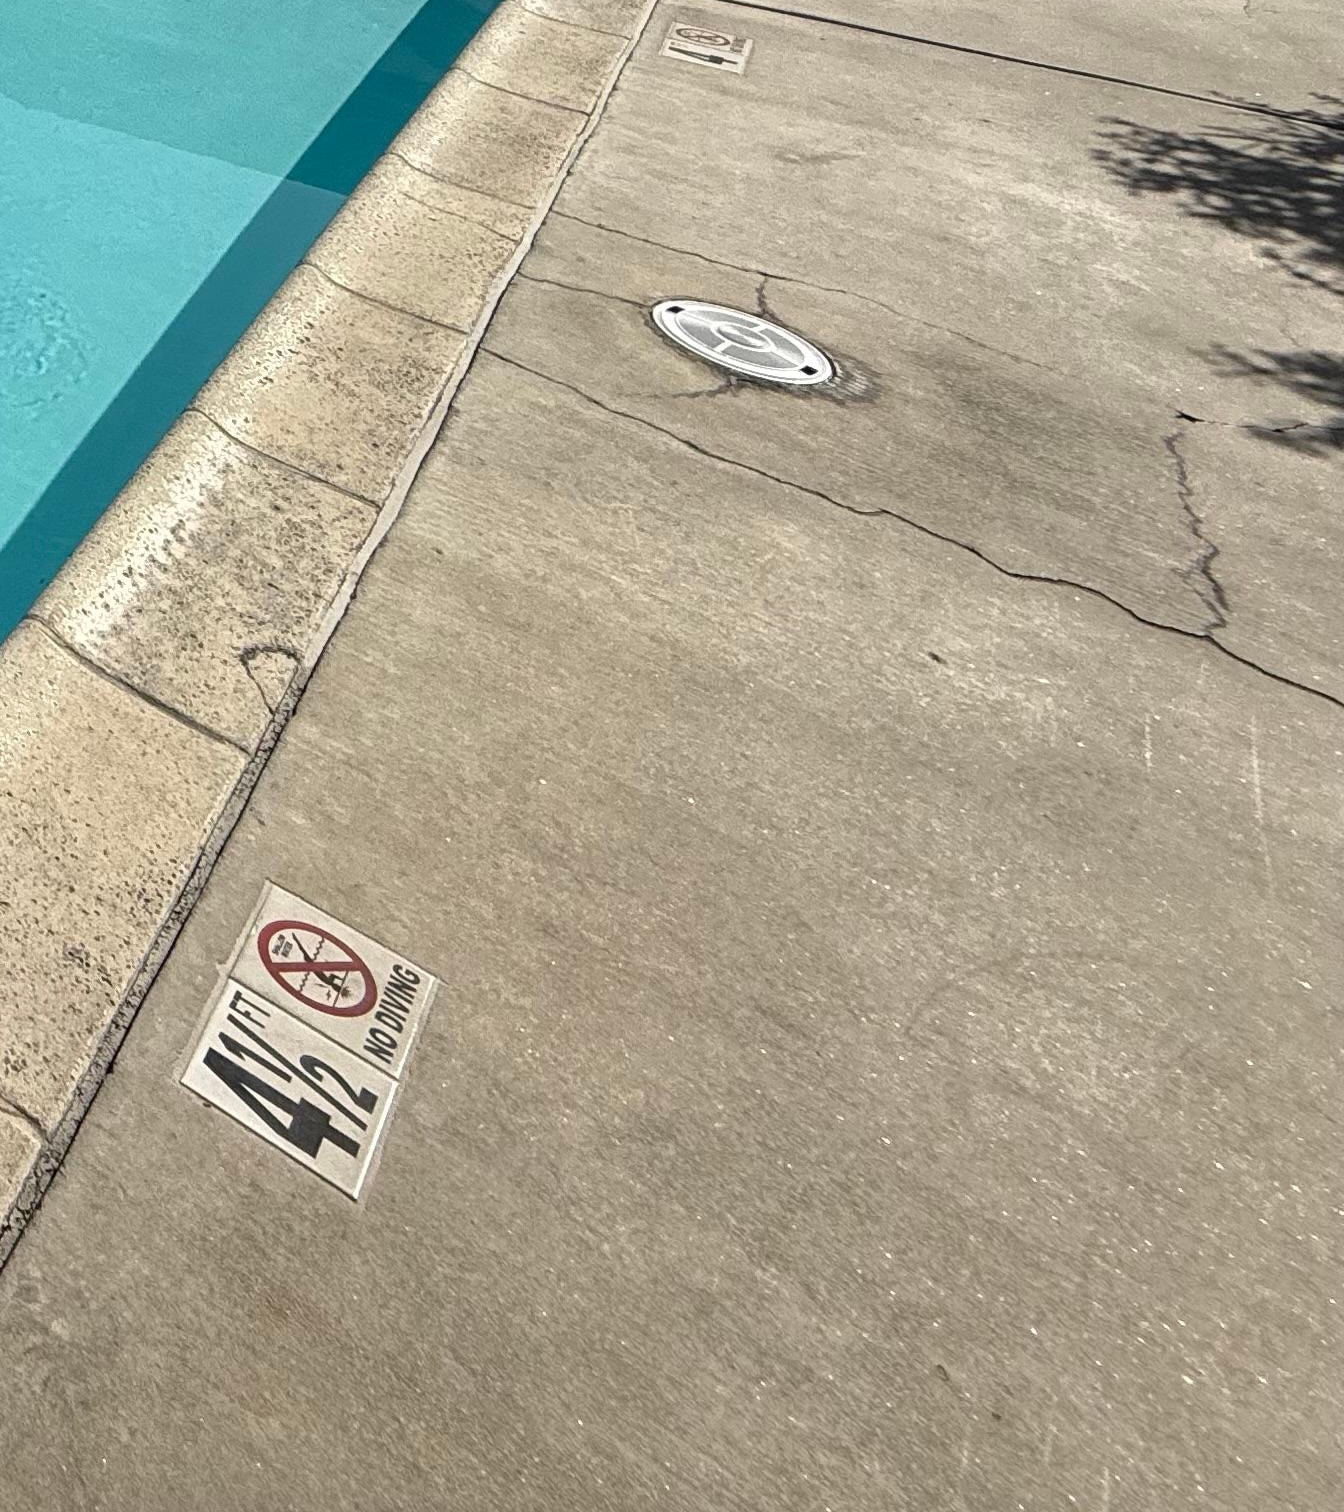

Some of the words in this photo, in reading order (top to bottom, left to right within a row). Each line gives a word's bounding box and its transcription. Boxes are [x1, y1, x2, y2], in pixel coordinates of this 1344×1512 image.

[668, 46, 738, 65] 4
[228, 991, 272, 1029] FT
[375, 963, 422, 1034] DIVING
[363, 1027, 399, 1065] NO
[202, 1046, 361, 1159] 4
